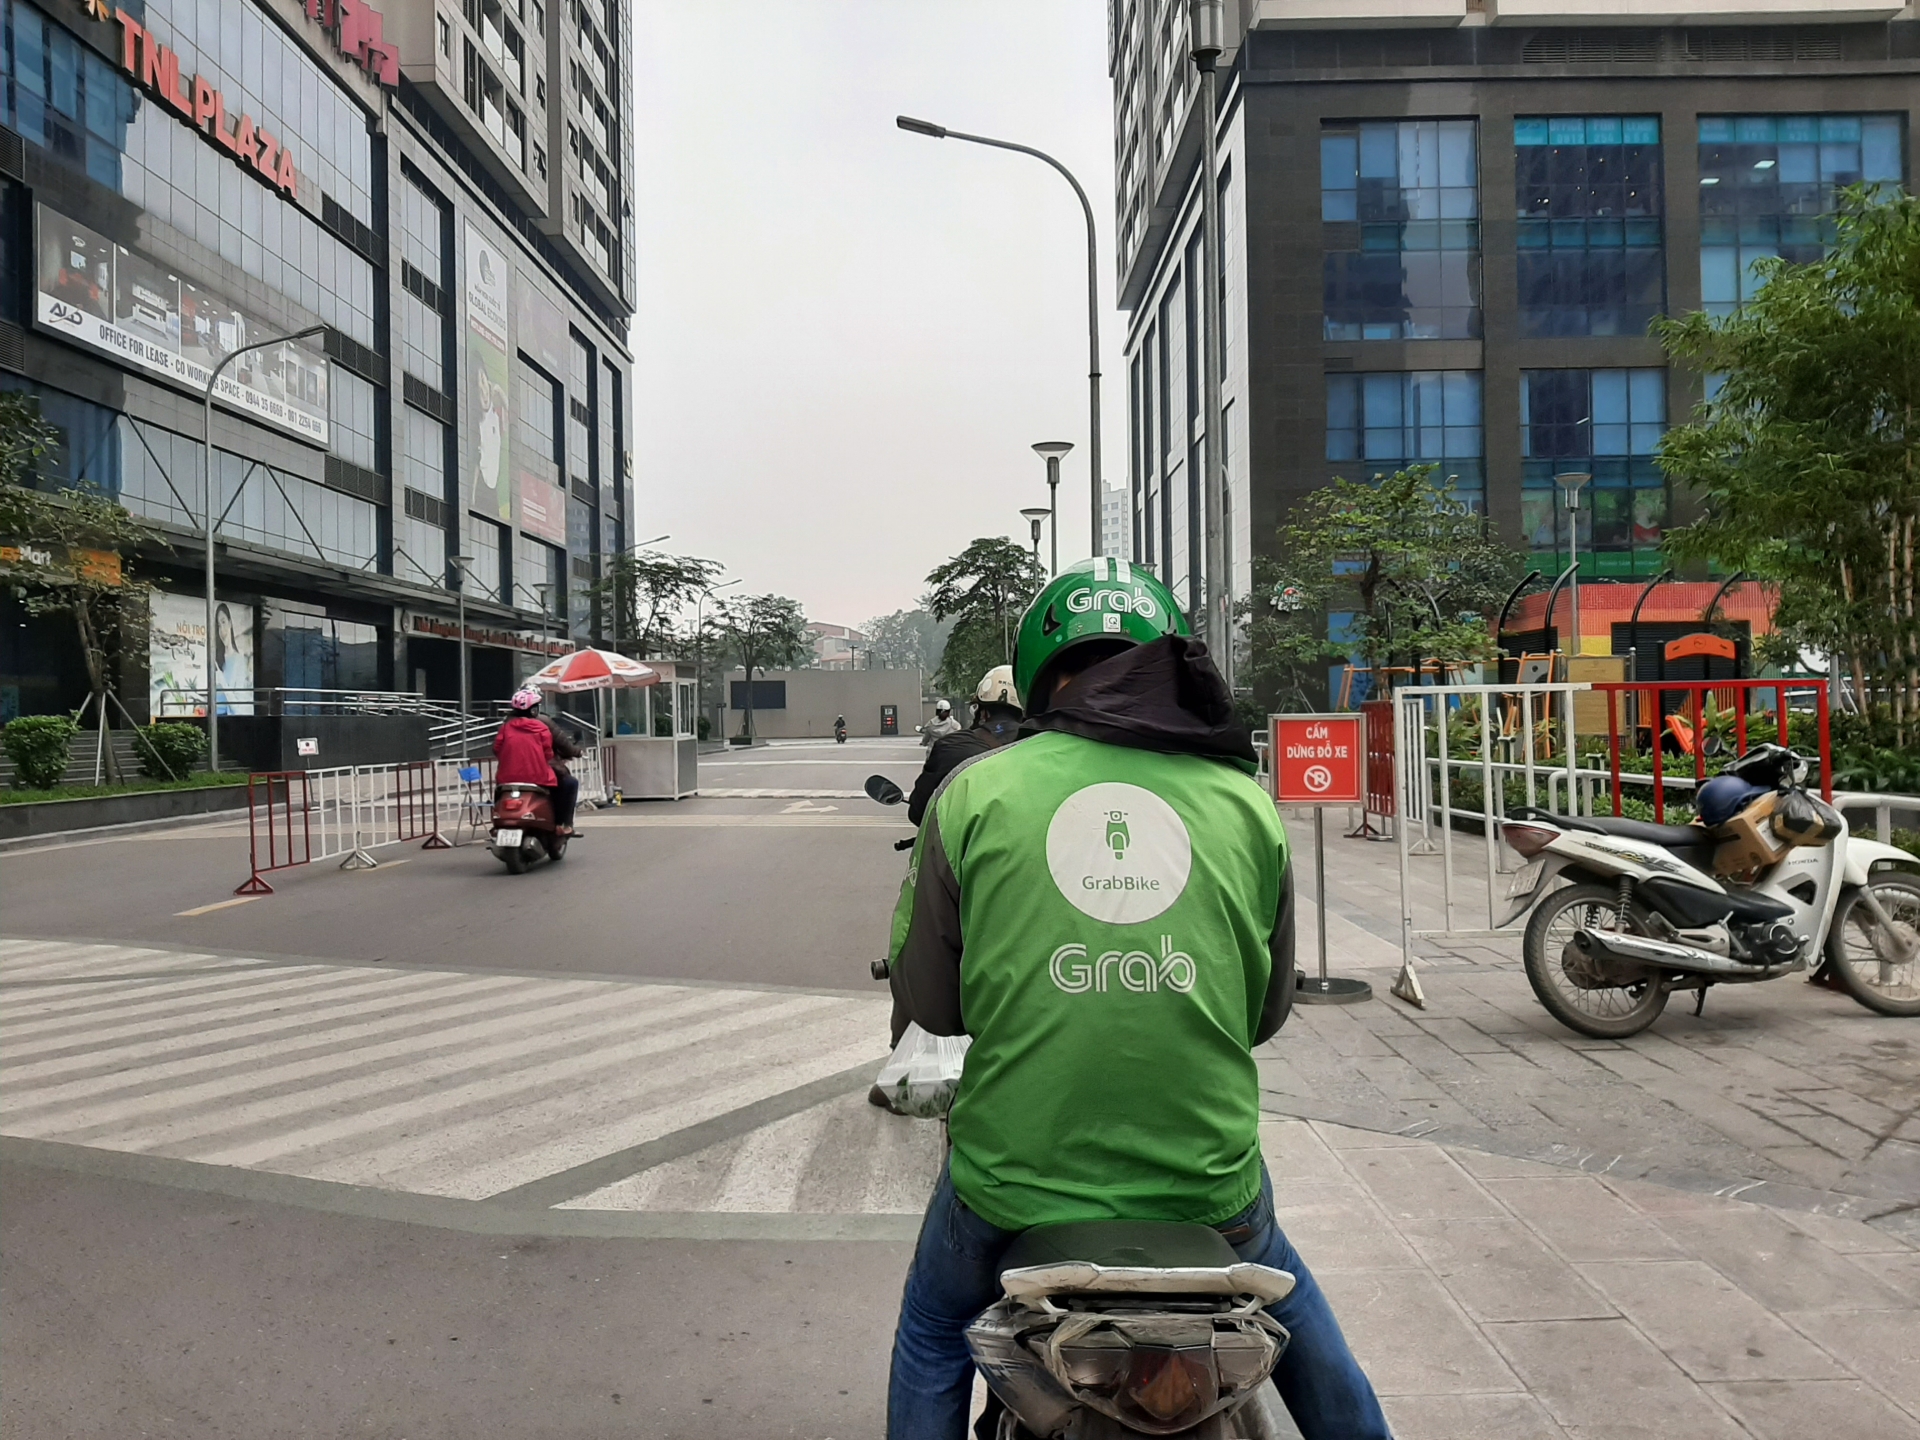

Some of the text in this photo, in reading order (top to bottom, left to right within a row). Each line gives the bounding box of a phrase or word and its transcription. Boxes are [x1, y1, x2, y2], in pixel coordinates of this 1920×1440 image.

[116, 8, 297, 200] TNL PLAZA
[99, 324, 127, 350] OFFICE
[129, 337, 144, 357] FOR
[145, 345, 169, 368] LEASE
[175, 358, 185, 375] CO
[187, 364, 219, 391] WORKIG
[220, 380, 240, 399] SPACE
[1066, 587, 1156, 619] Grab
[1306, 721, 1328, 739] CẤM
[1286, 740, 1348, 759] DỪNG ĐỖ XE
[1082, 875, 1160, 891] GrabBike
[1049, 934, 1197, 994] Grab
